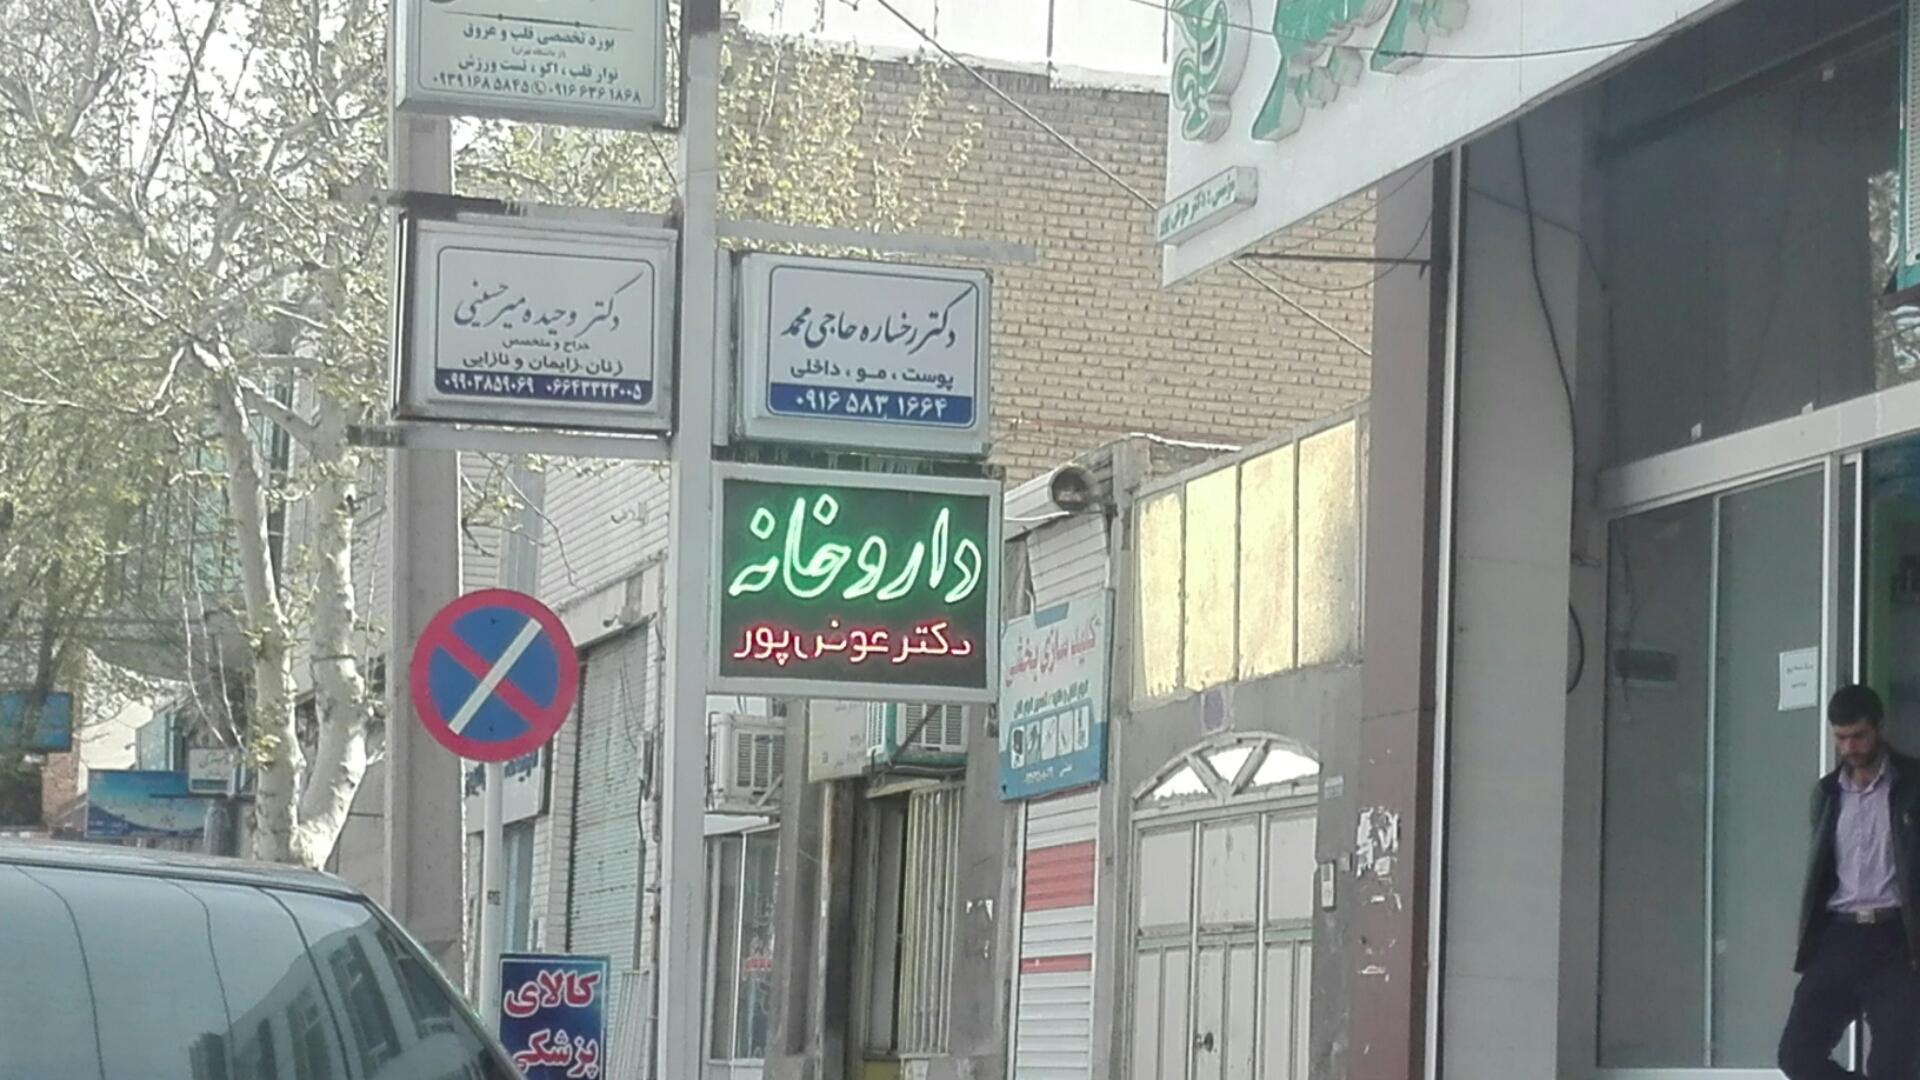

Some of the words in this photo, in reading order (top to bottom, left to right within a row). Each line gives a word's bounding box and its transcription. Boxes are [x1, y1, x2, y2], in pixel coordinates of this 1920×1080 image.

[462, 23, 497, 39] عروق
[500, 29, 507, 42] و
[510, 26, 534, 41] قلب
[537, 31, 586, 46] تخصصی
[458, 53, 497, 73] ورزش
[500, 59, 527, 72] تست
[596, 66, 619, 84] نوار
[574, 270, 644, 338] دکتر
[522, 304, 578, 336] وحیده
[780, 305, 813, 338] محمد
[804, 308, 858, 350] حاجی
[859, 311, 919, 347] رخساره
[906, 286, 974, 356] دکتر
[502, 337, 551, 350] متخصص
[553, 341, 560, 351] و
[563, 338, 590, 353] جراح
[462, 350, 510, 368] نازایی
[514, 356, 524, 370] و
[528, 354, 580, 374] زایمان
[790, 357, 841, 379] داخلی
[728, 492, 982, 603] داروخانه
[733, 626, 790, 666] پور
[892, 621, 972, 663] دکتر
[503, 968, 602, 1018] کالای
